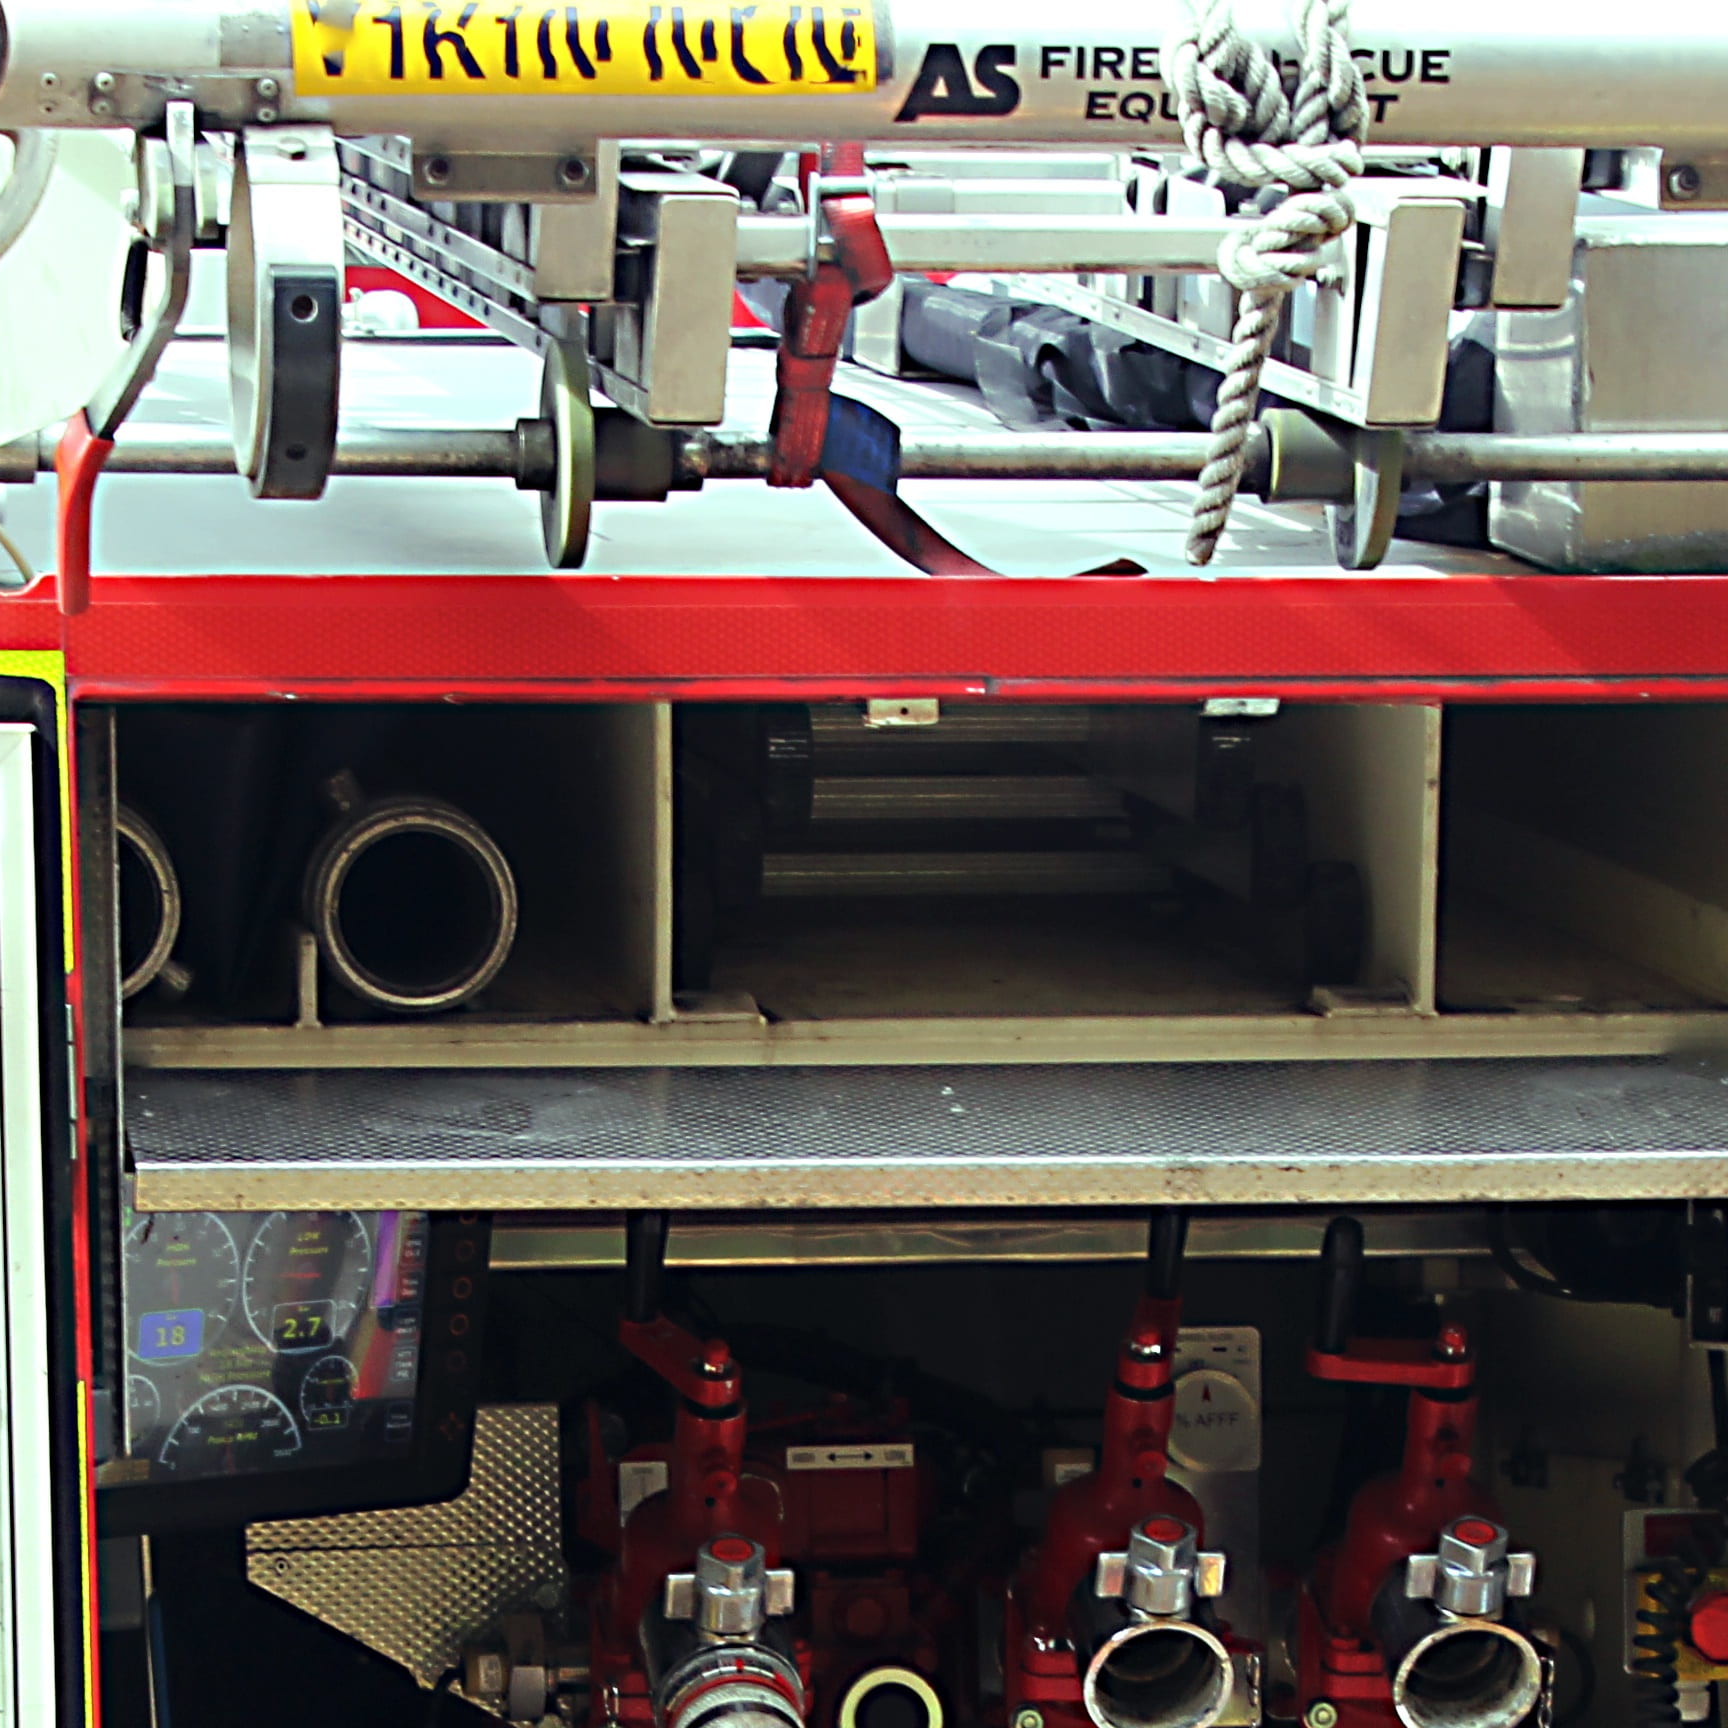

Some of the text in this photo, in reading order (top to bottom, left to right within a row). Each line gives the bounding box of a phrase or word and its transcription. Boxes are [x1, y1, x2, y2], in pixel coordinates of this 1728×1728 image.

[1040, 46, 1162, 80] FIRE
[894, 43, 1021, 122] AS
[156, 1326, 185, 1347] 18
[282, 1316, 321, 1339] 2.7
[1195, 1412, 1239, 1426] AFFF
